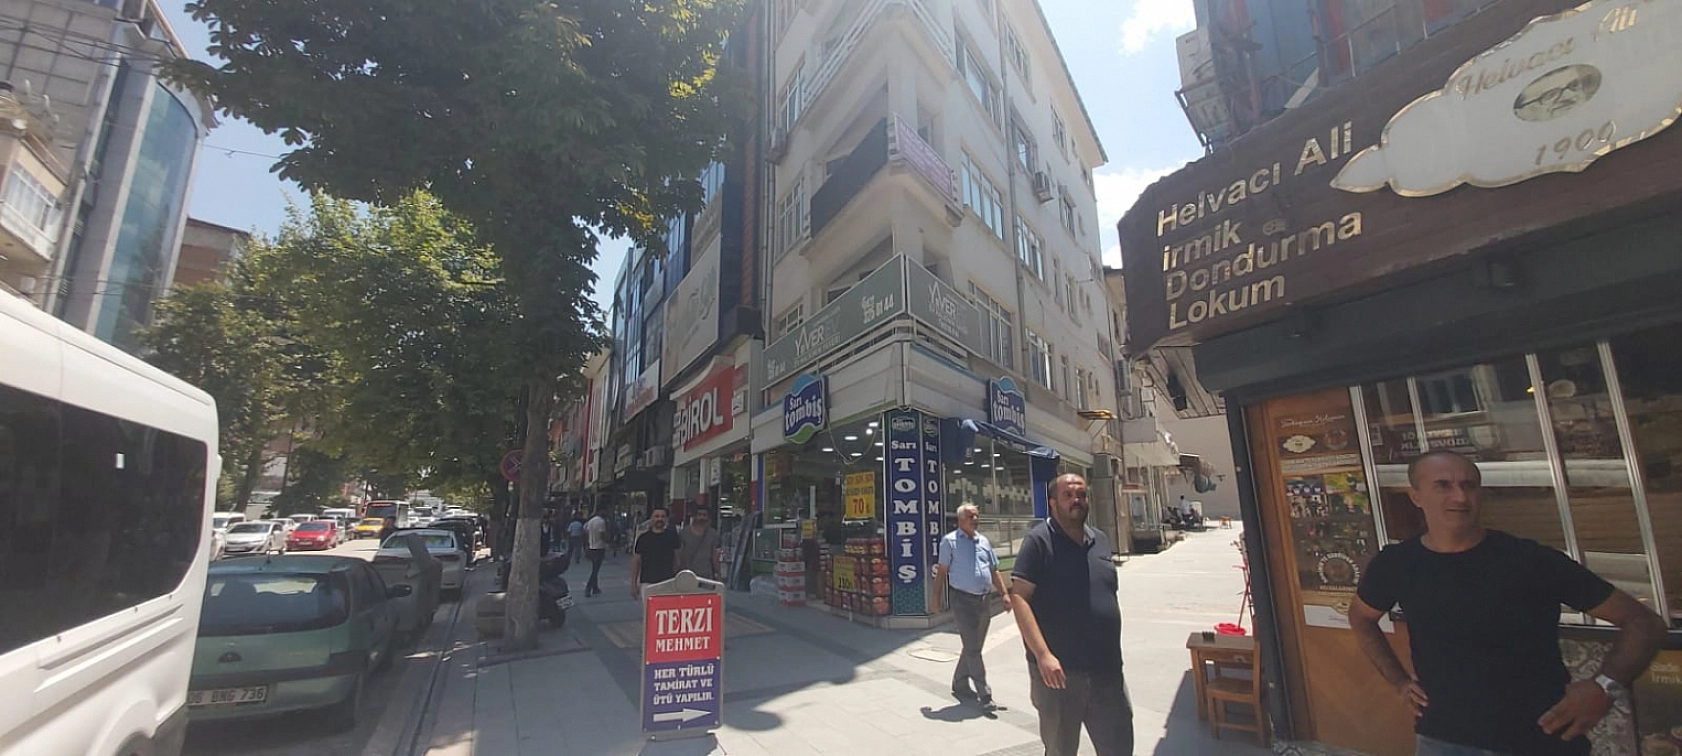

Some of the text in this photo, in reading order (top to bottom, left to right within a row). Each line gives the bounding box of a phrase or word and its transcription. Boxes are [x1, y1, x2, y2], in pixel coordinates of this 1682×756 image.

[1535, 120, 1617, 165] 1900
[1157, 121, 1352, 237] Helvacı Ali
[1166, 211, 1362, 301] Dondurma
[1169, 274, 1285, 330] Lokum
[680, 387, 723, 446] BİROL
[786, 395, 822, 431] tombiş
[891, 440, 917, 449] Sarı
[852, 497, 864, 514] 70
[893, 457, 918, 583] TOMBİŞ
[656, 599, 713, 635] TERZİ
[656, 636, 711, 652] MEHMET
[654, 663, 714, 679] HER TÜRLÜ
[654, 679, 713, 691] TAMİRAT VE
[653, 693, 673, 705] ÜTÜ
